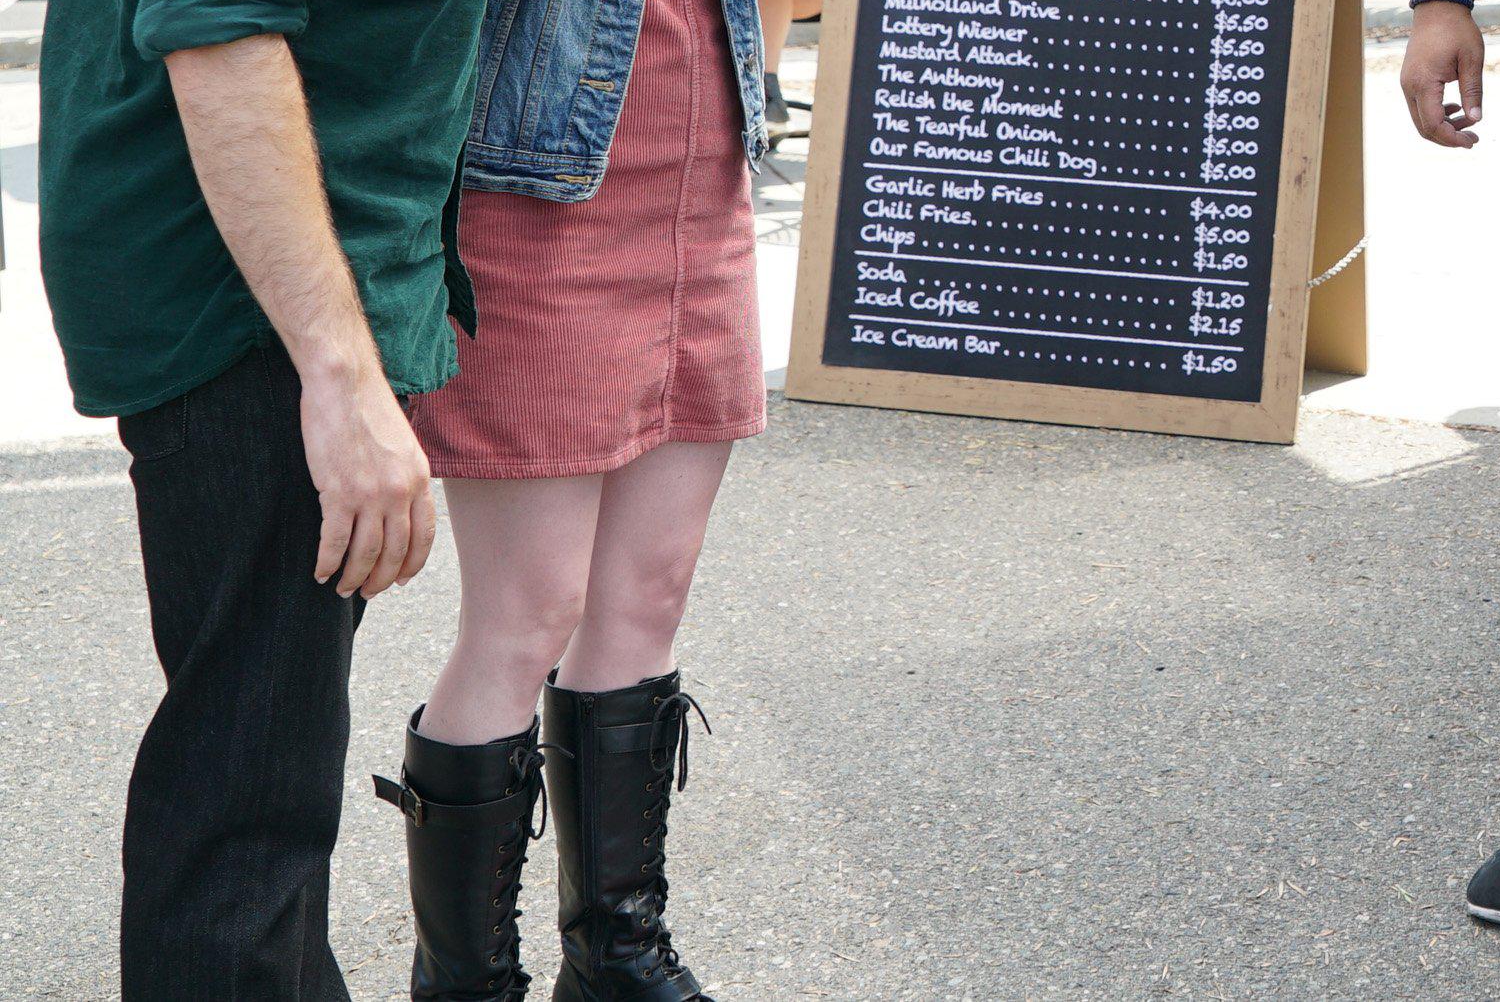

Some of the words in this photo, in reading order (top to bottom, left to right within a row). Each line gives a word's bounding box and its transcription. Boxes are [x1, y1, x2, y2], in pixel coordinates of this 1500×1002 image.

[881, 15, 953, 43] Lottery
[957, 21, 1028, 43] Wiener
[1209, 35, 1265, 59] $5.50
[1008, 0, 1061, 20] Drive
[1213, 9, 1269, 35] $5.50
[879, 41, 962, 62] Mustard
[964, 47, 1032, 67] Attack
[1208, 59, 1265, 84] $5.00
[877, 64, 915, 84] The
[918, 67, 1005, 94] Anthony
[1204, 84, 1261, 109] $5.00
[874, 88, 936, 110] Relish
[942, 91, 975, 113] the
[980, 92, 1064, 119] Moment
[1203, 110, 1260, 134] $5.00
[872, 112, 911, 133] The
[915, 115, 989, 142] Tearful
[996, 123, 1059, 143] Onion
[1202, 136, 1259, 159] $5.00
[869, 137, 908, 157] Our
[913, 140, 994, 164] Famous
[999, 146, 1051, 168] Chili
[1056, 151, 1097, 178] Dog
[1199, 160, 1256, 184] $5.00
[865, 174, 935, 197] Garlic
[941, 179, 986, 202] Herb
[991, 184, 1044, 206] Fries
[1189, 196, 1253, 222] $4.00
[862, 199, 914, 221] Chili
[919, 204, 972, 225] Fries
[1193, 222, 1251, 247] $5.00
[858, 223, 916, 255] Chips
[1193, 247, 1248, 273] $1.50
[857, 261, 908, 283] Soda
[1191, 286, 1245, 311] $1.20
[854, 286, 904, 307] Iced
[909, 289, 981, 317] Coffee
[1188, 312, 1243, 337] $2.15
[850, 324, 886, 345] Ice
[891, 328, 958, 351] Cream
[964, 335, 1001, 355] Bar
[1181, 350, 1238, 376] $1.50
